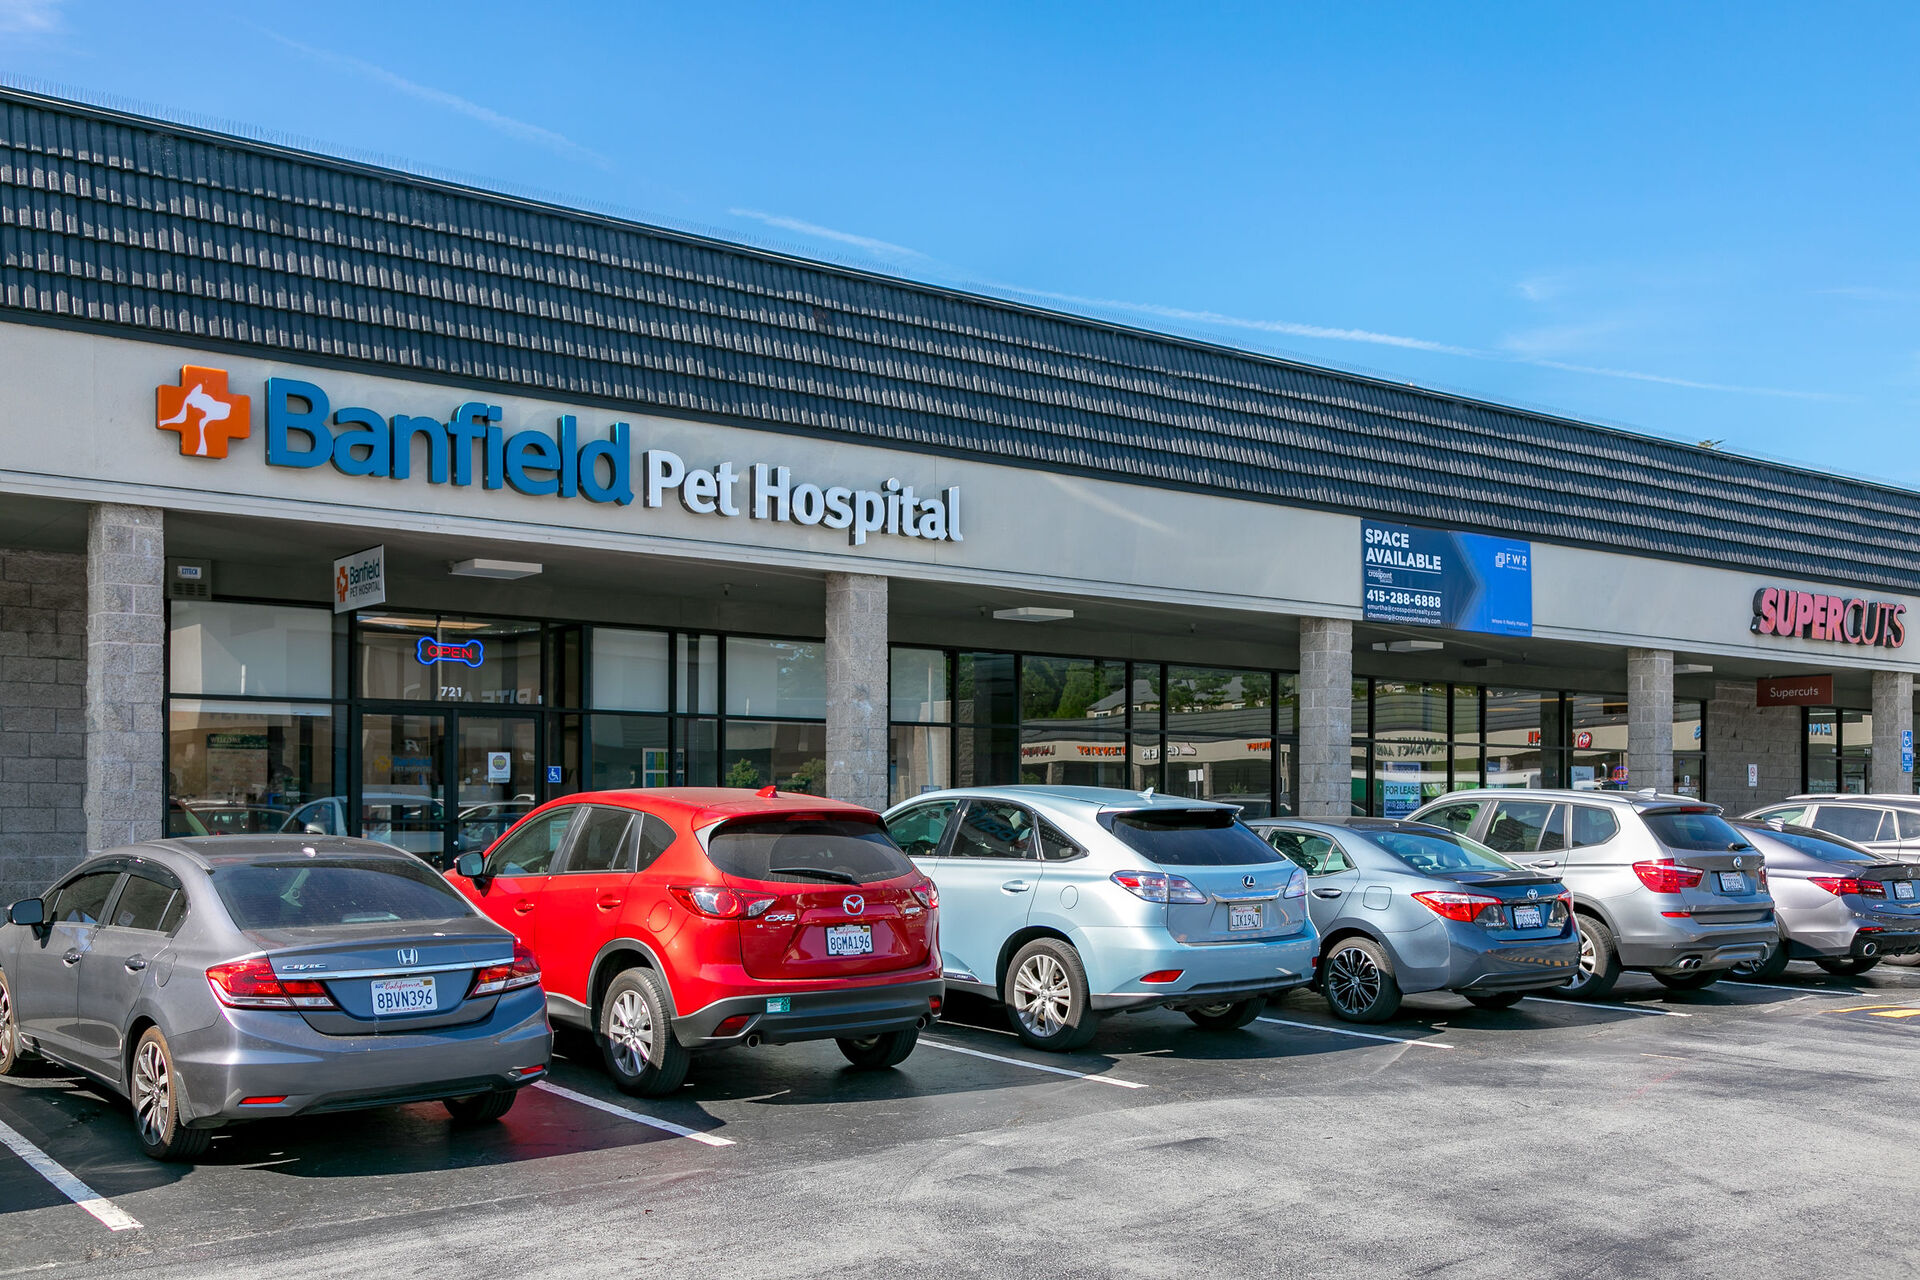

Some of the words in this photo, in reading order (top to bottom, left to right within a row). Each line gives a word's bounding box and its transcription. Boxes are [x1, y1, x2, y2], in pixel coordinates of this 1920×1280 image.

[265, 377, 634, 505] Banfield
[644, 450, 739, 517] Pet
[751, 463, 963, 545] Hospital
[1365, 528, 1410, 549] SPACE
[1365, 547, 1442, 571] AVAILABLE
[350, 557, 380, 585] Banfield
[350, 586, 358, 598] PET
[358, 580, 381, 596] HOSPITAL
[1367, 589, 1441, 608] 415-288-6888
[1755, 587, 1907, 649] SUPERCUTS
[427, 645, 473, 659] OPEN
[440, 686, 462, 697] 721
[1770, 687, 1819, 699] Supercuts
[1385, 785, 1399, 795] FOR
[1400, 785, 1420, 795] LEASE
[765, 914, 796, 922] CX-5
[830, 935, 870, 950] 8GMA196
[282, 963, 326, 971] CIVIC
[385, 981, 420, 991] California
[377, 989, 433, 1009] 8BVN396
